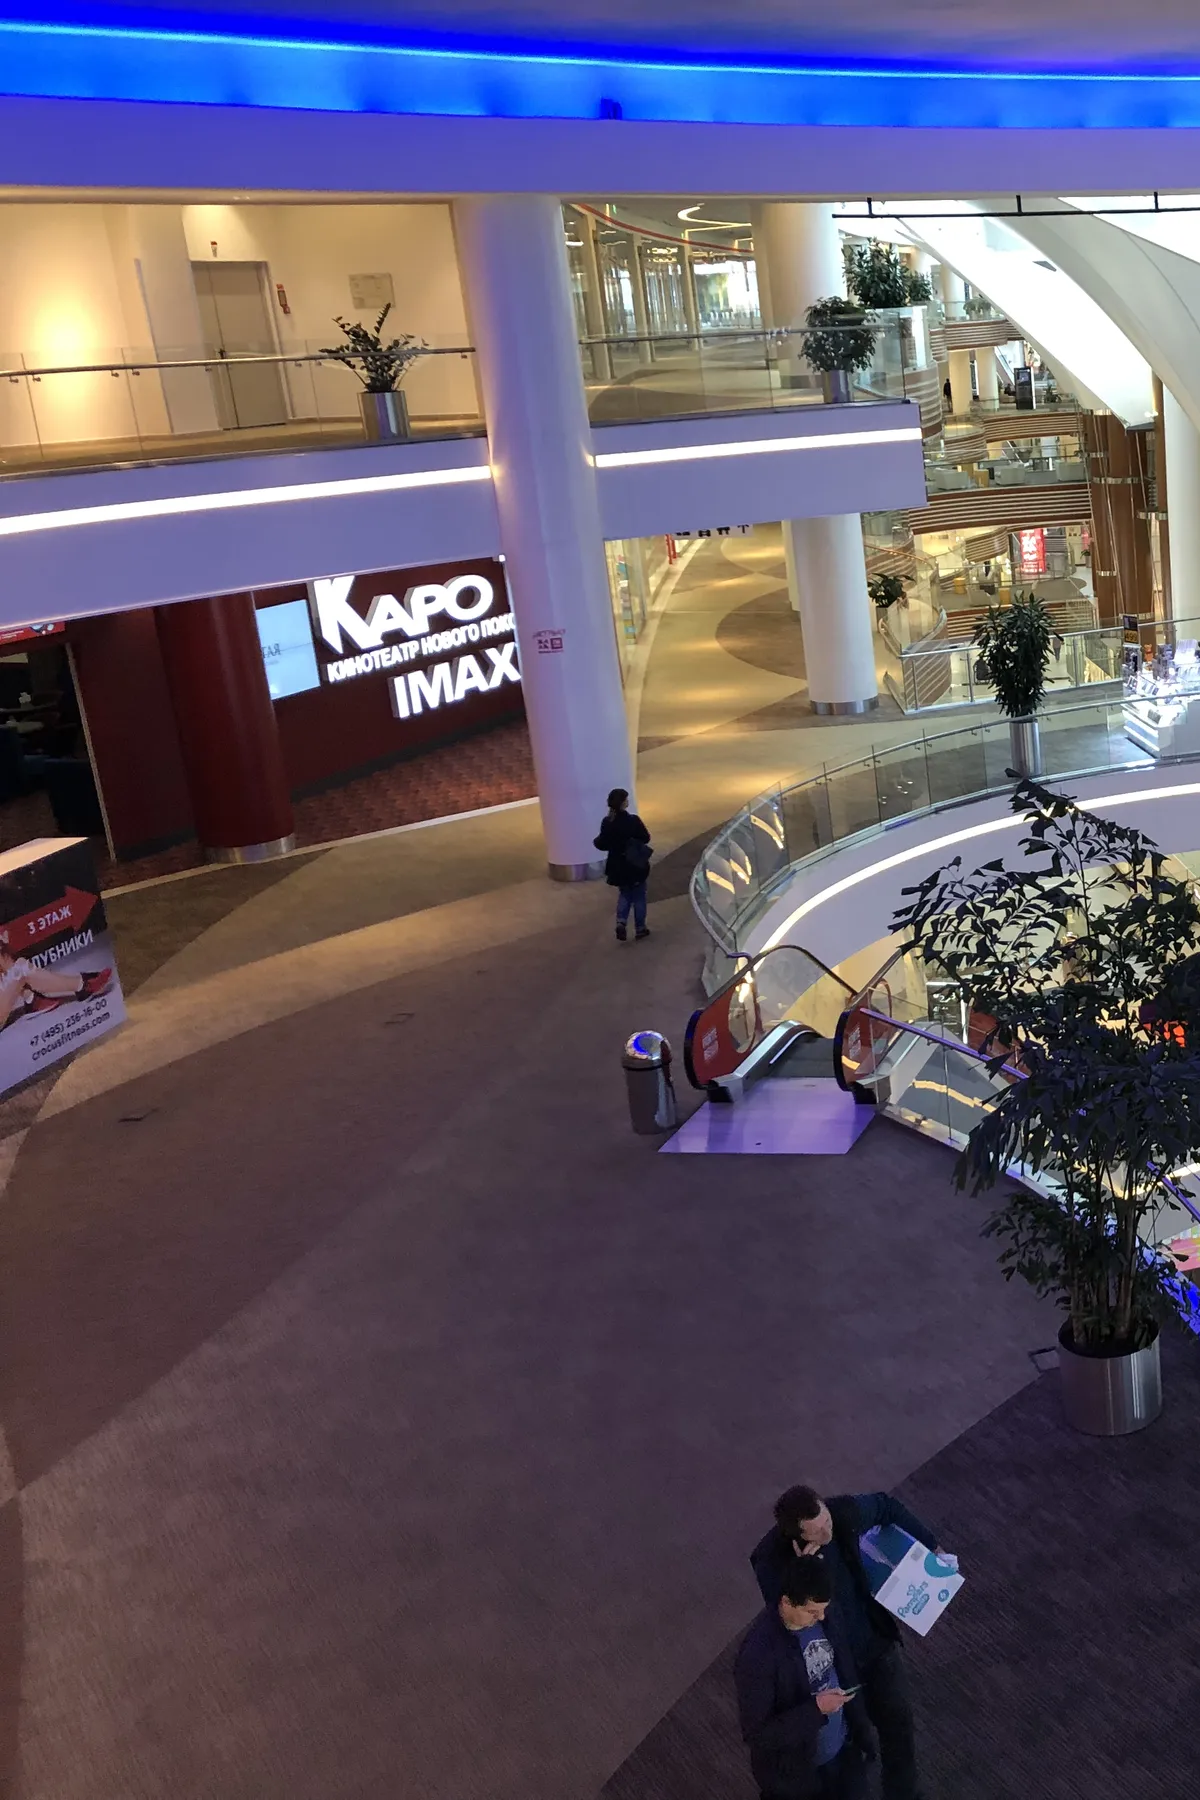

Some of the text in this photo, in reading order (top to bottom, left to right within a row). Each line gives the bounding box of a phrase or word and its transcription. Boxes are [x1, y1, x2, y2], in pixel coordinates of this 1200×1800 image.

[326, 642, 421, 684] КИНОТЕАТР
[421, 623, 480, 656] НОВОГО
[391, 642, 522, 720] IMAX
[27, 905, 72, 935] 3 ЭТАЖ
[28, 929, 94, 970] ЛУБНИКИ
[29, 998, 107, 1047] +7 (495) 236-16-00
[31, 1011, 111, 1061] crocusfitness.com
